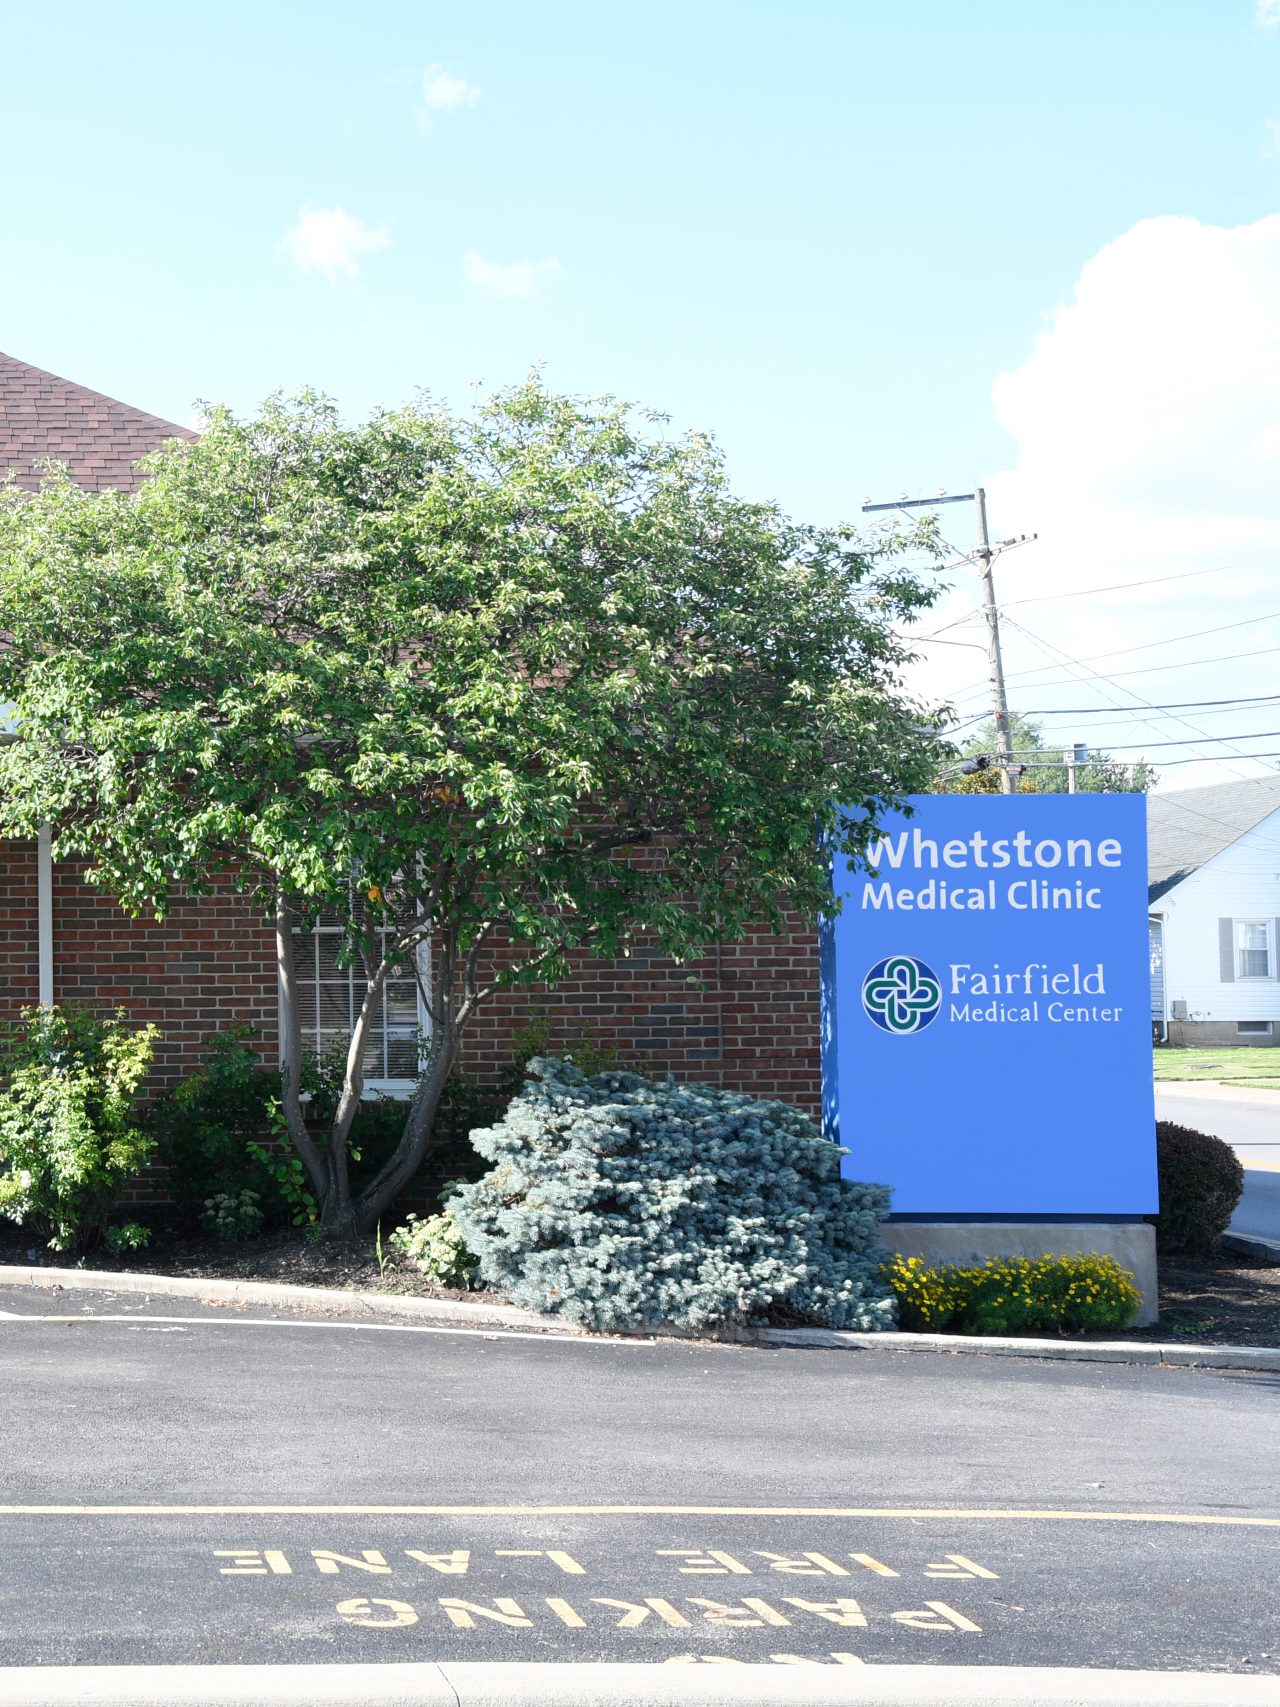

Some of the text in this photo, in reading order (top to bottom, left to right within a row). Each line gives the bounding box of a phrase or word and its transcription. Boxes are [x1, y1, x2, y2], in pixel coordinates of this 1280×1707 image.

[866, 827, 1123, 869] Whetstone
[861, 879, 1102, 911] Medical Clinic
[949, 963, 1106, 995] Fairfield
[949, 1001, 1123, 1022] Medical Center
[212, 1549, 1001, 1579] FIRE LANE
[335, 1597, 983, 1632] PARKING
